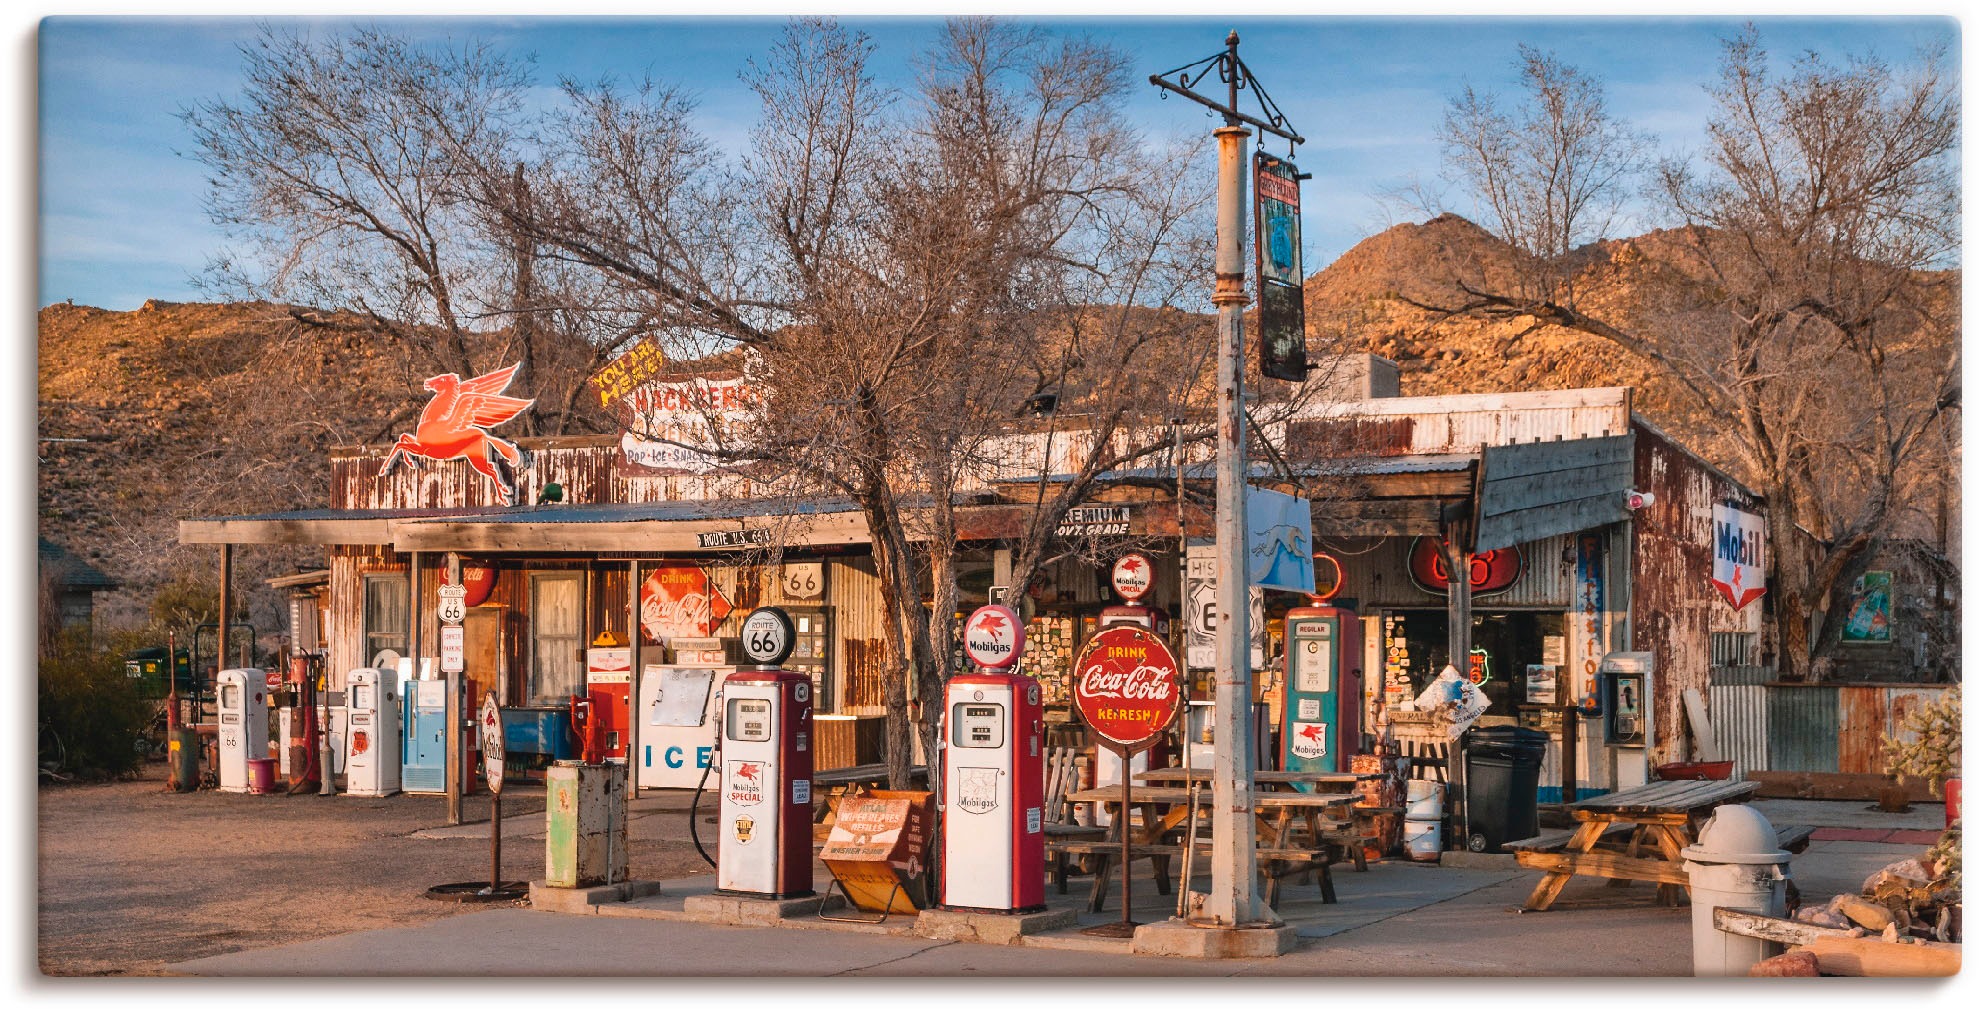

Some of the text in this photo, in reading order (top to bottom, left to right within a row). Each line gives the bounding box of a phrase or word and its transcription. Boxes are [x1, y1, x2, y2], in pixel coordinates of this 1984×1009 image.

[593, 360, 625, 388] YOU
[1061, 508, 1124, 523] REMIUM
[1057, 525, 1083, 536] OVT.
[704, 532, 729, 546] ROUTE
[733, 531, 748, 544] U.S.
[1717, 520, 1761, 568] Mobil
[661, 574, 694, 584] DRINK
[790, 572, 816, 591] 66
[1116, 577, 1146, 588] Mobilgas
[445, 606, 460, 619] 66
[751, 621, 774, 629] ROUTE
[1584, 536, 1598, 711] Firestone
[751, 632, 776, 653] 66
[968, 640, 1011, 655] Mobilgas
[697, 650, 722, 663] ICE
[1108, 646, 1148, 658] DRINK
[1080, 664, 1174, 701] Coca-Cola
[226, 736, 237, 747] 66
[1295, 744, 1325, 755] Mobilgas
[645, 745, 713, 769] ICE
[733, 784, 760, 793] Mobilgas
[731, 792, 761, 801] SPECIAL
[960, 796, 995, 809] Mobilgas
